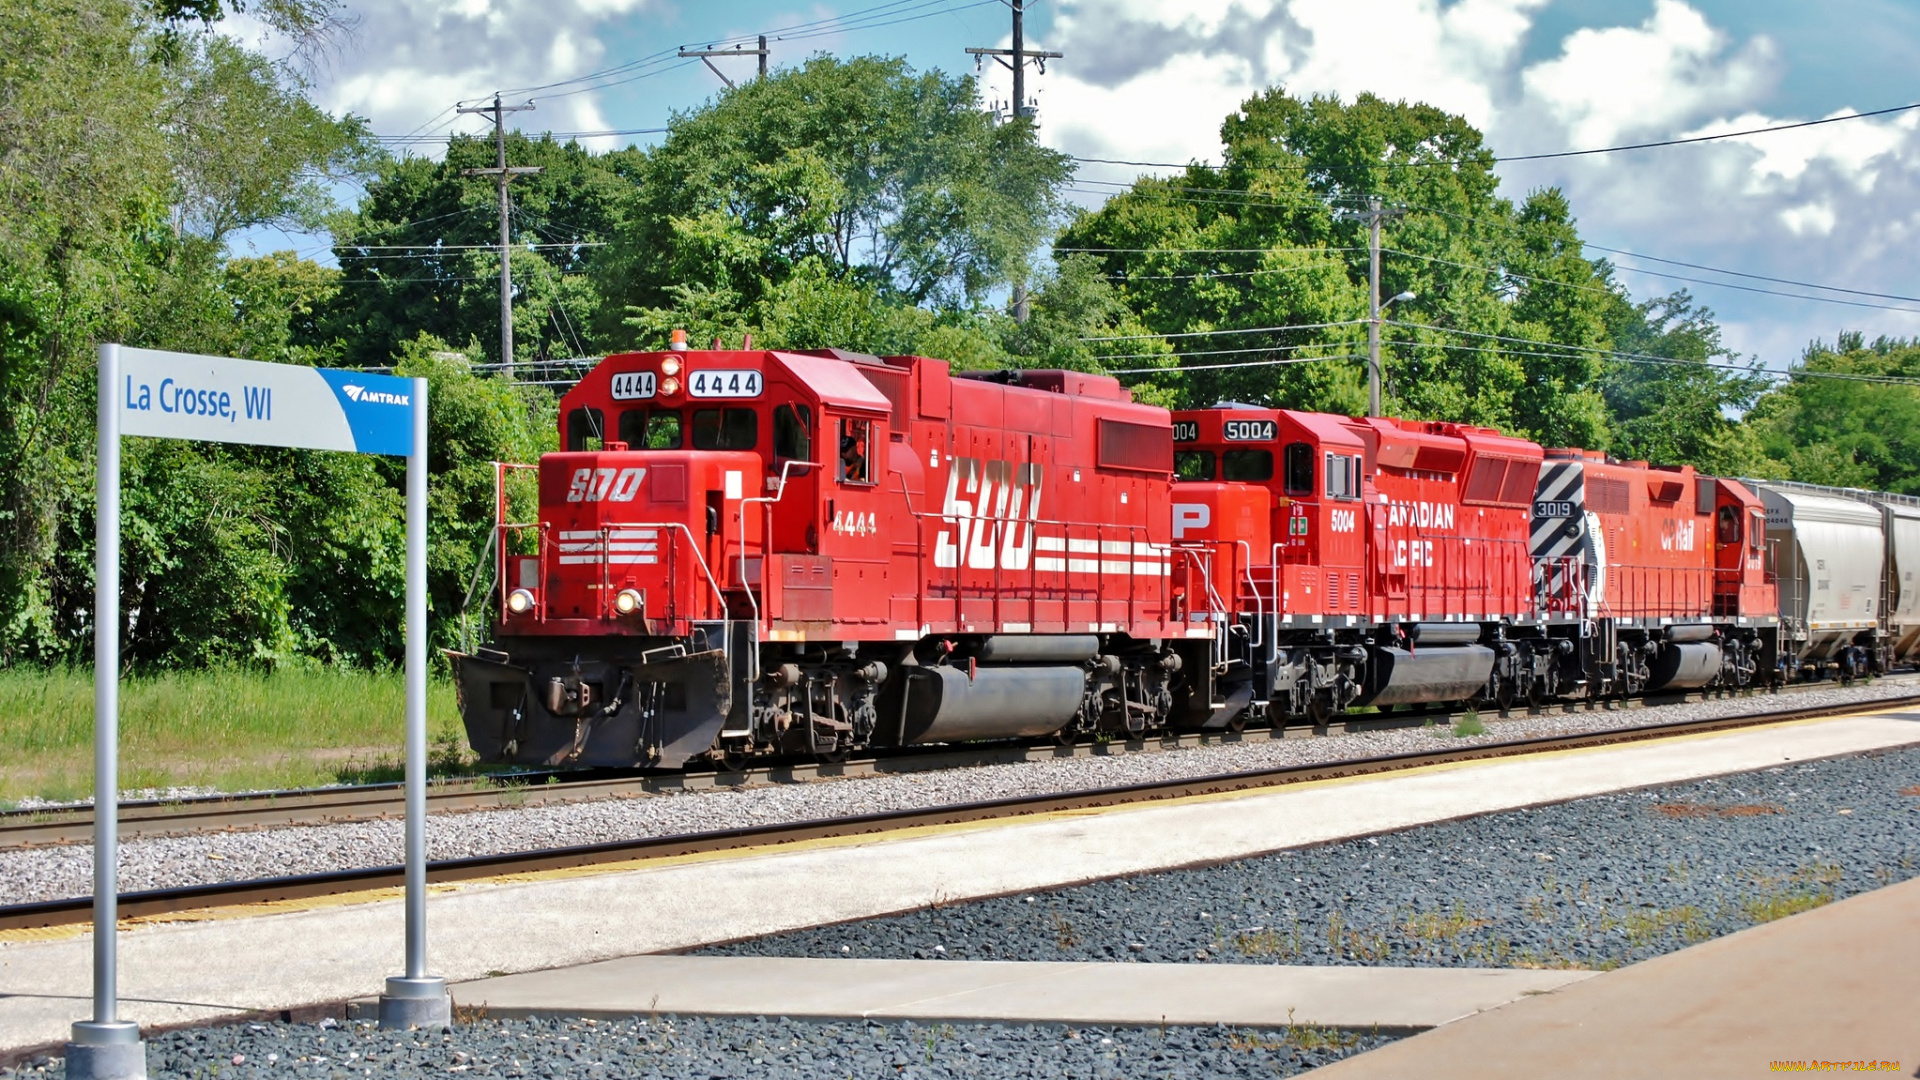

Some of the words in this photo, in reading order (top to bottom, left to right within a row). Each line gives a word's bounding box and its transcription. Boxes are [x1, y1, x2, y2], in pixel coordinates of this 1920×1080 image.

[615, 375, 653, 396] 4444
[694, 373, 757, 394] 4444
[126, 375, 150, 411] La
[159, 378, 236, 422] Crosse,
[244, 386, 271, 420] WI
[361, 391, 409, 406] AMTRAK
[1172, 423, 1196, 440] 004
[1227, 422, 1273, 439] 5004
[567, 467, 647, 502] SOO
[1537, 502, 1570, 516] 3019
[833, 510, 876, 537] 4444
[1172, 503, 1210, 539] P
[1331, 509, 1355, 533] 5004
[1675, 518, 1695, 551] Rail
